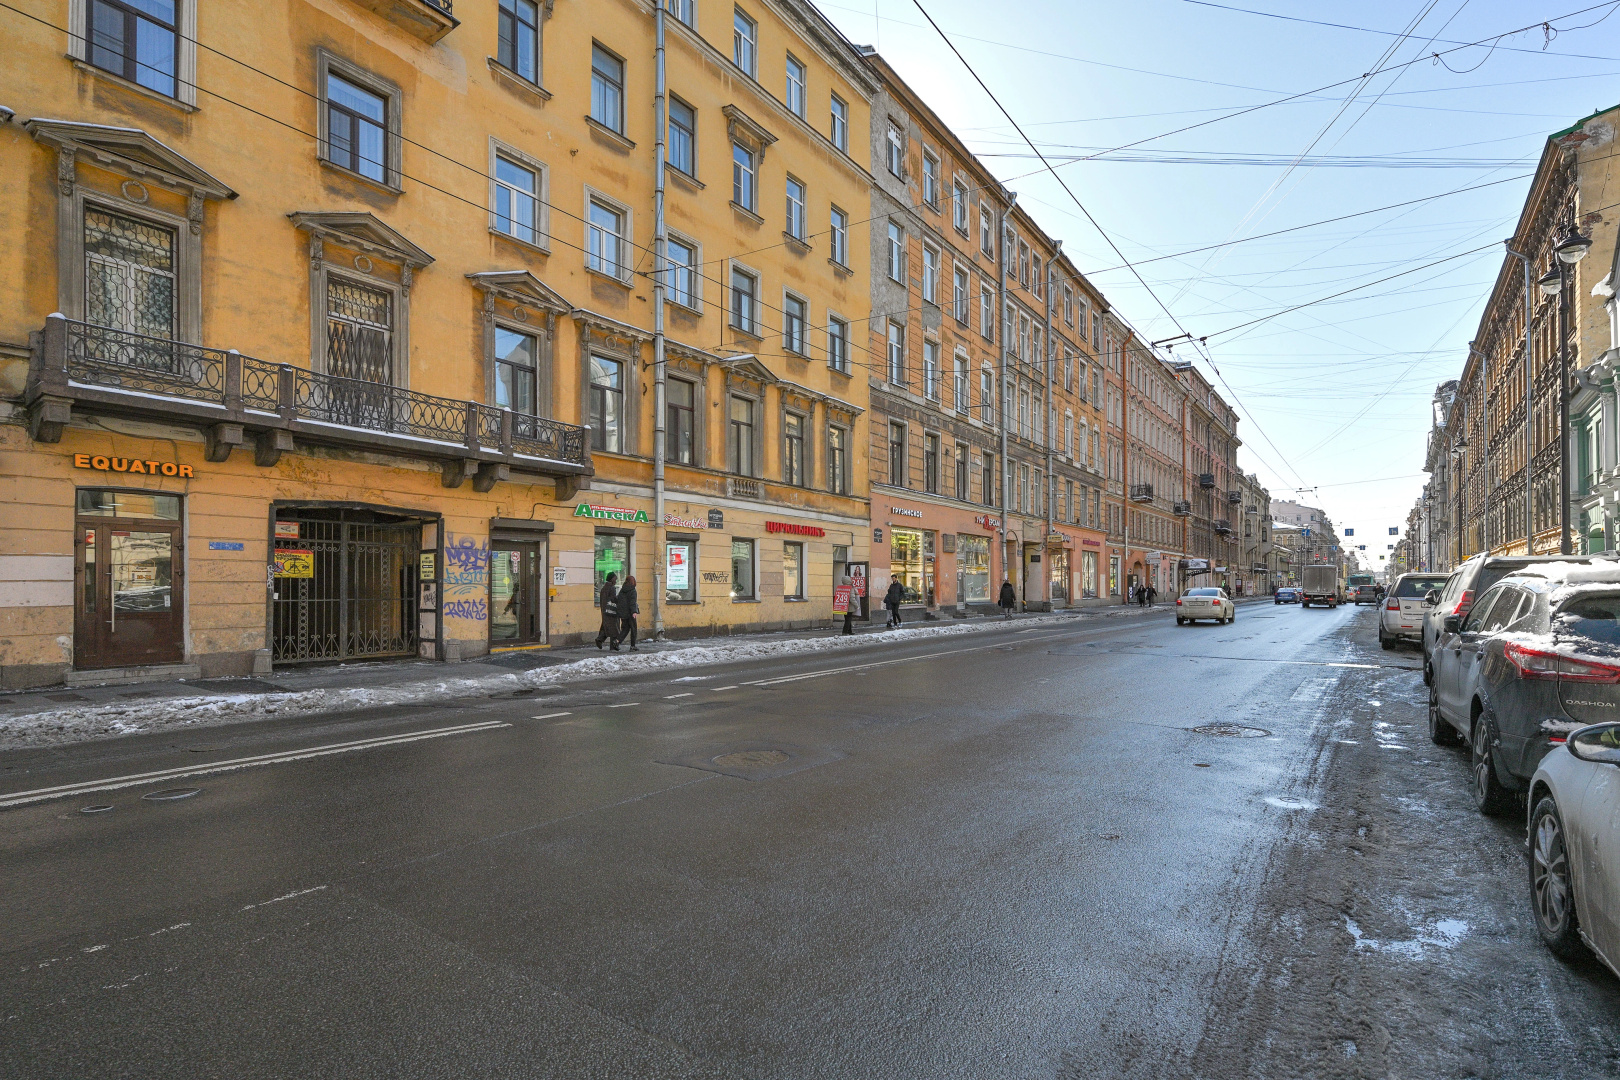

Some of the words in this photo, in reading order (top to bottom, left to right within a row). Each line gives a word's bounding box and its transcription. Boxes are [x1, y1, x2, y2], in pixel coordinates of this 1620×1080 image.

[74, 453, 194, 478] EQUATOR
[766, 521, 826, 537] ЦИРЮЛЬНИКЪ
[1565, 699, 1616, 708] QASHQAI
